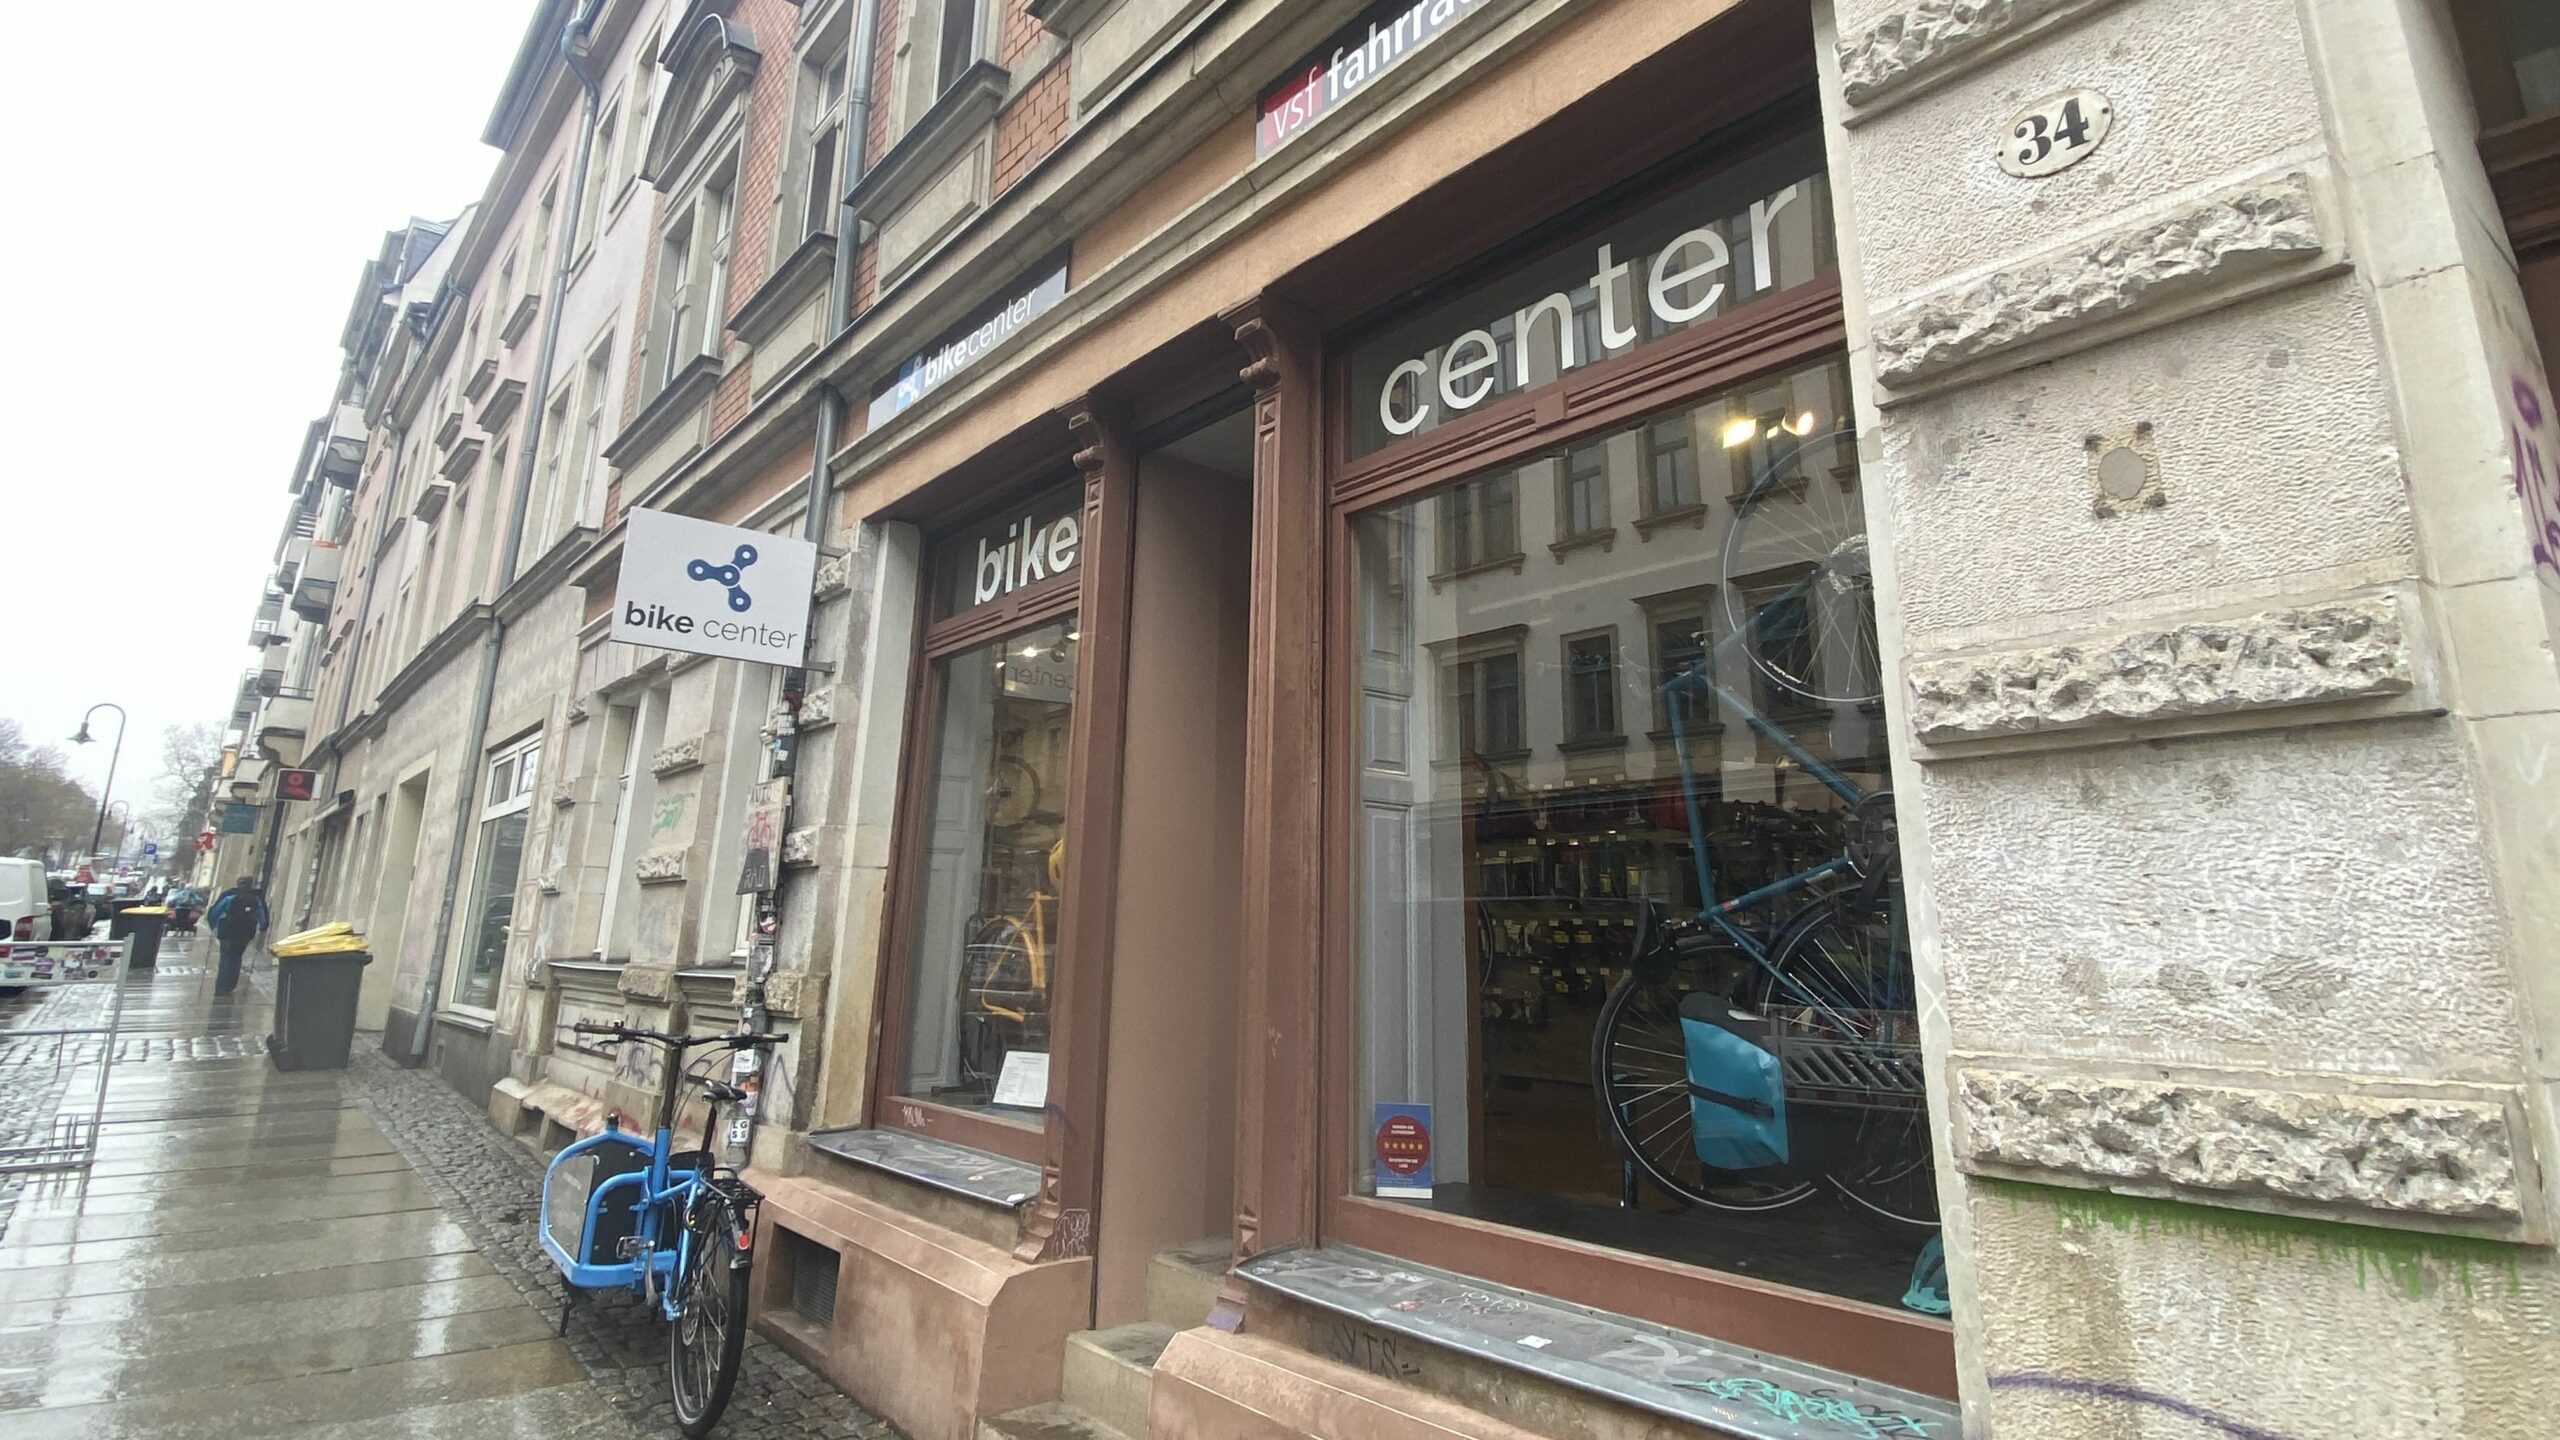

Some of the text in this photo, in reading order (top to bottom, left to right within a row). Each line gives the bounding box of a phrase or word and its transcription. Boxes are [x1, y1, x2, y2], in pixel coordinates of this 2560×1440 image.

[1272, 0, 1473, 139] vsf fahrra
[2013, 97, 2091, 166] 34
[1378, 184, 1798, 437] center
[974, 515, 1079, 606] bike
[624, 600, 798, 650] bike center
[145, 844, 155, 853] P
